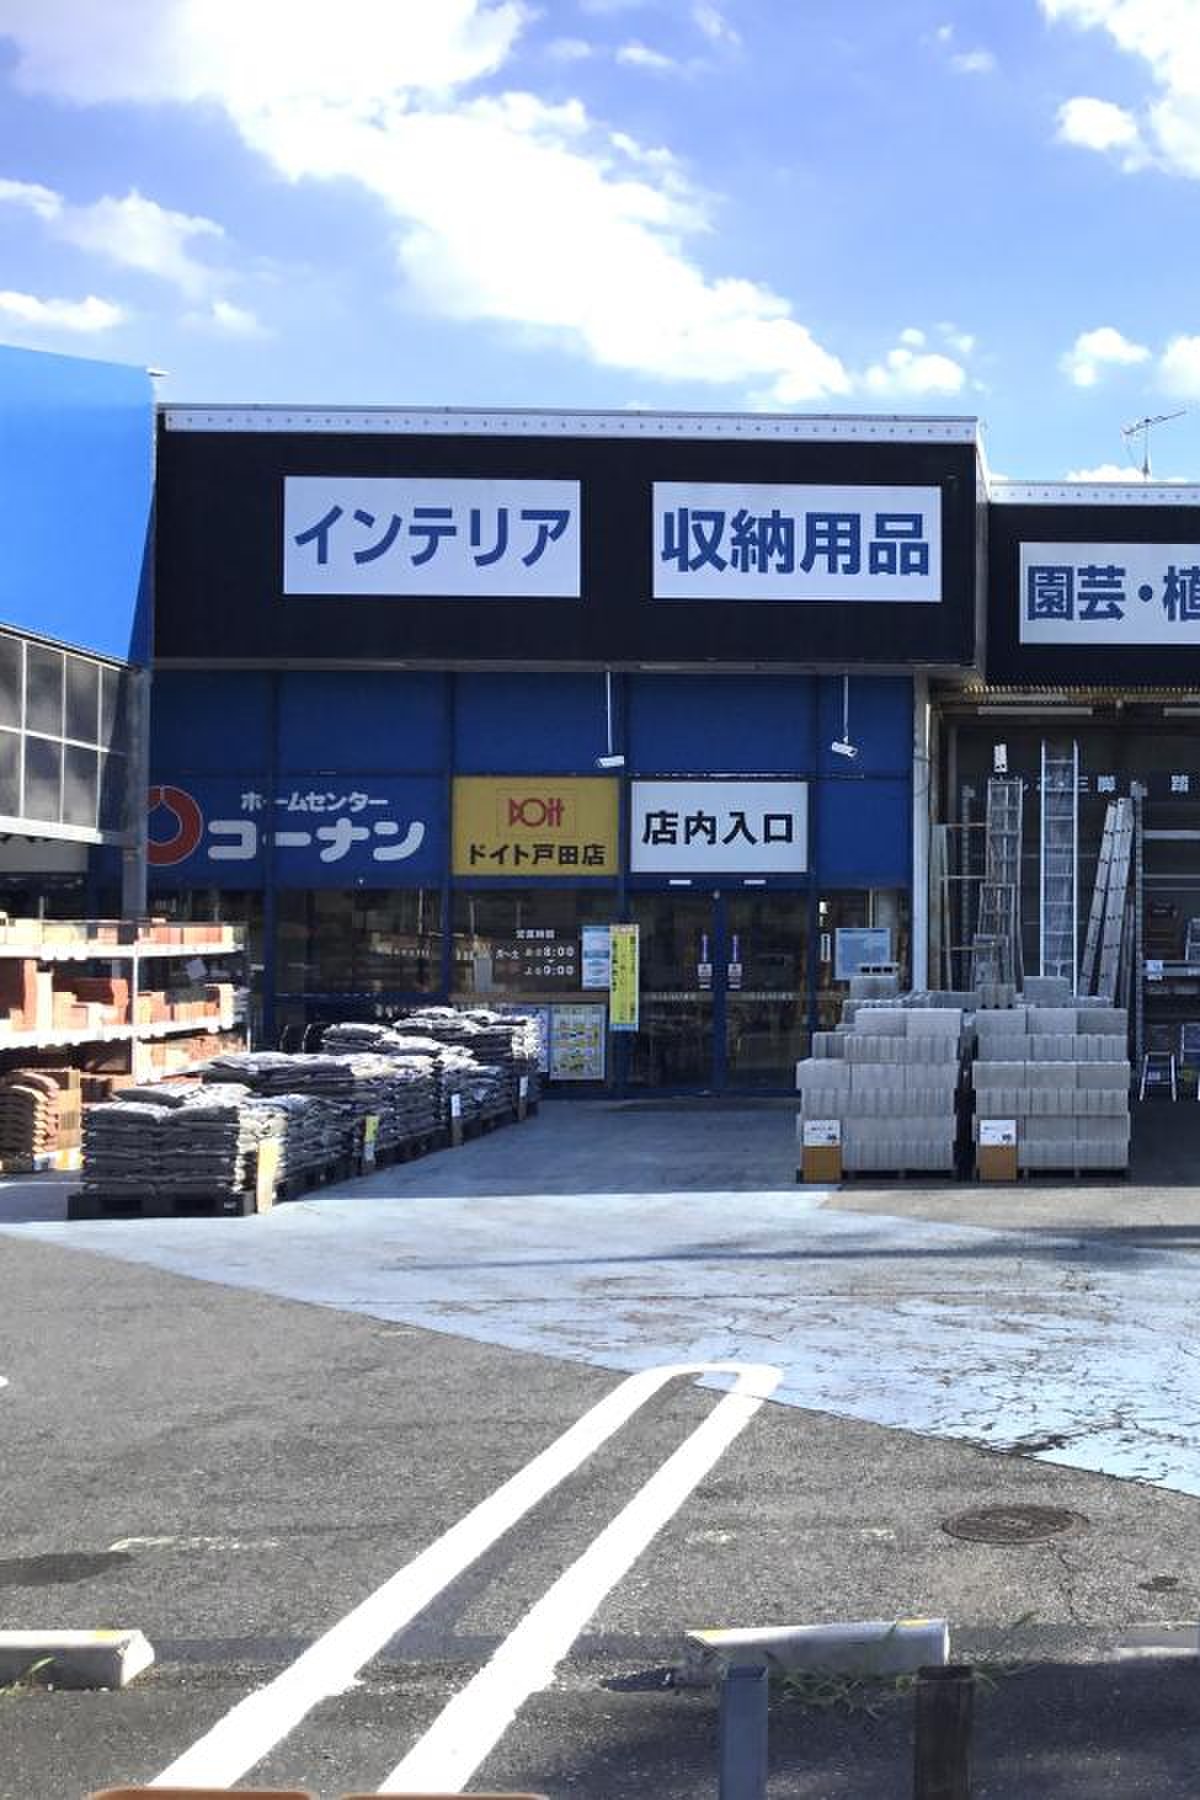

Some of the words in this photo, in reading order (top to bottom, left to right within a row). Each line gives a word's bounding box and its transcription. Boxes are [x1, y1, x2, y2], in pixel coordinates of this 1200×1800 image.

[295, 505, 571, 567] インテリア
[661, 508, 931, 576] 収納用品
[240, 791, 389, 812] ホームセンター
[207, 817, 426, 863] コーナン
[642, 810, 794, 846] 店内入口
[468, 844, 606, 866] ドイト戸田店
